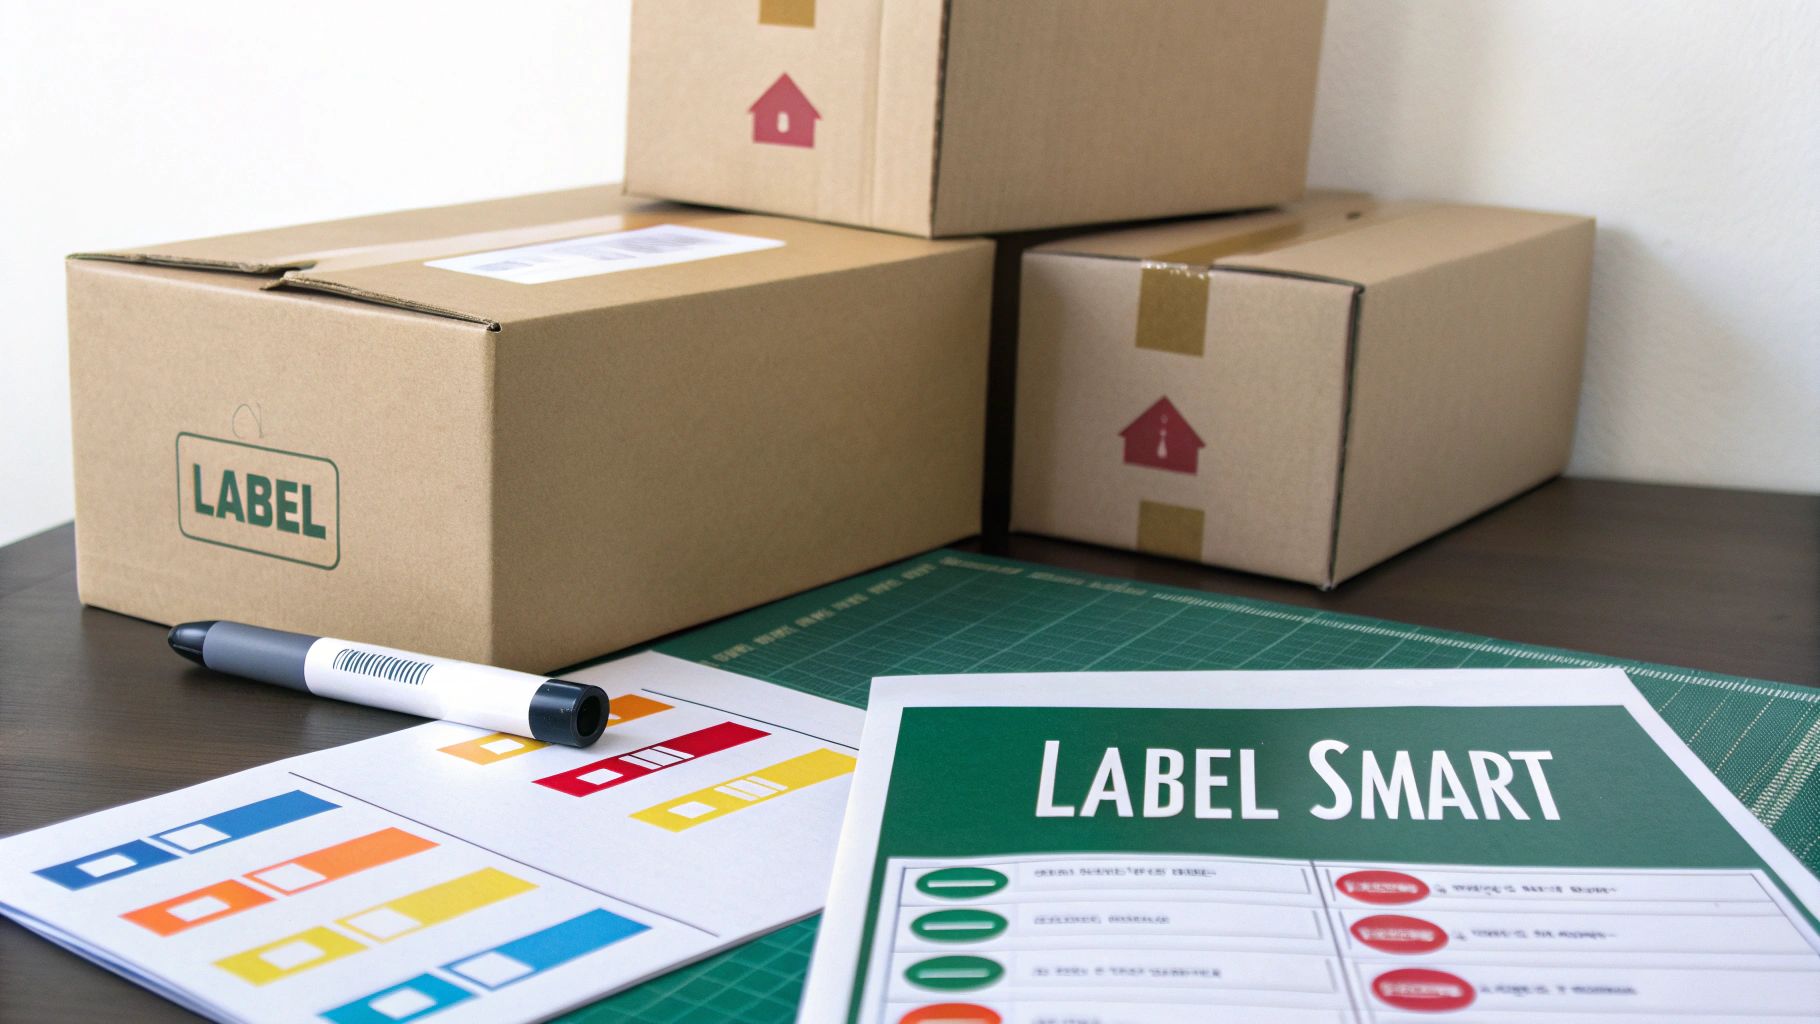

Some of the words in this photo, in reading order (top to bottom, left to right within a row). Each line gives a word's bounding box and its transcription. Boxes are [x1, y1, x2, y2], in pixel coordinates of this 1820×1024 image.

[193, 463, 326, 540] LABEL
[1035, 739, 1279, 820] LABEL
[1309, 739, 1561, 821] SMART
